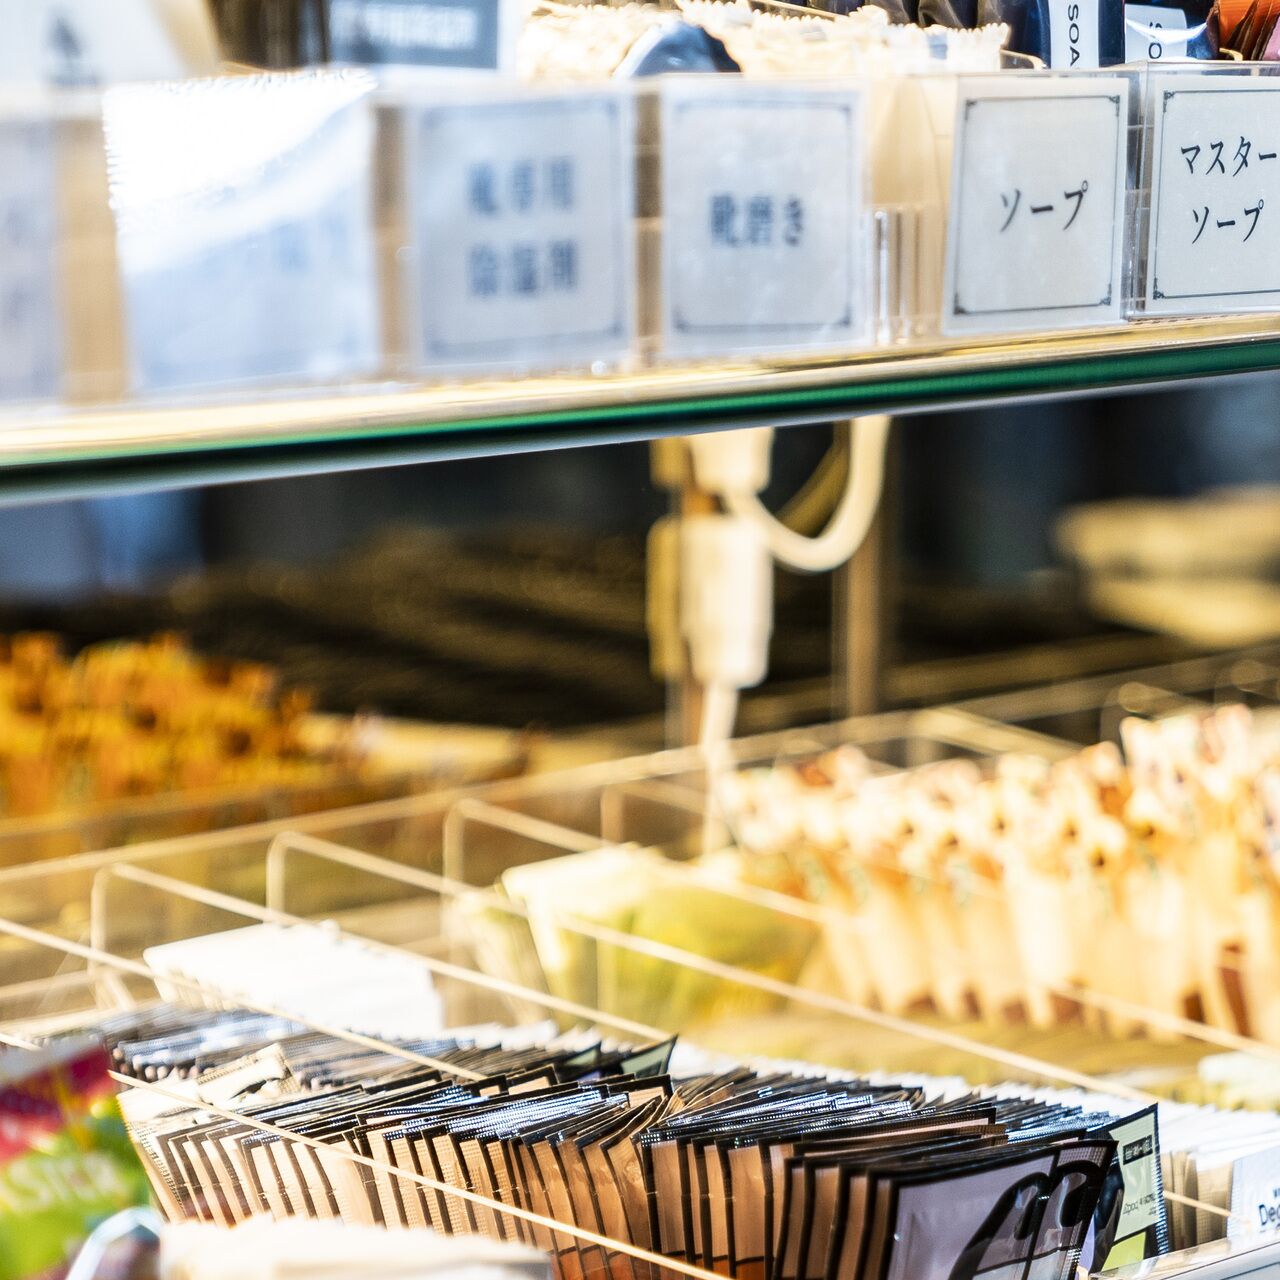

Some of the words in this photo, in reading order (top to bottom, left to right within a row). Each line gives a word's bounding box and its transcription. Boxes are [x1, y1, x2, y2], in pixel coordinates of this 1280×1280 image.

[1179, 135, 1278, 176] マスター
[1000, 179, 1090, 233] ソープ
[1191, 198, 1265, 244] ソープ
